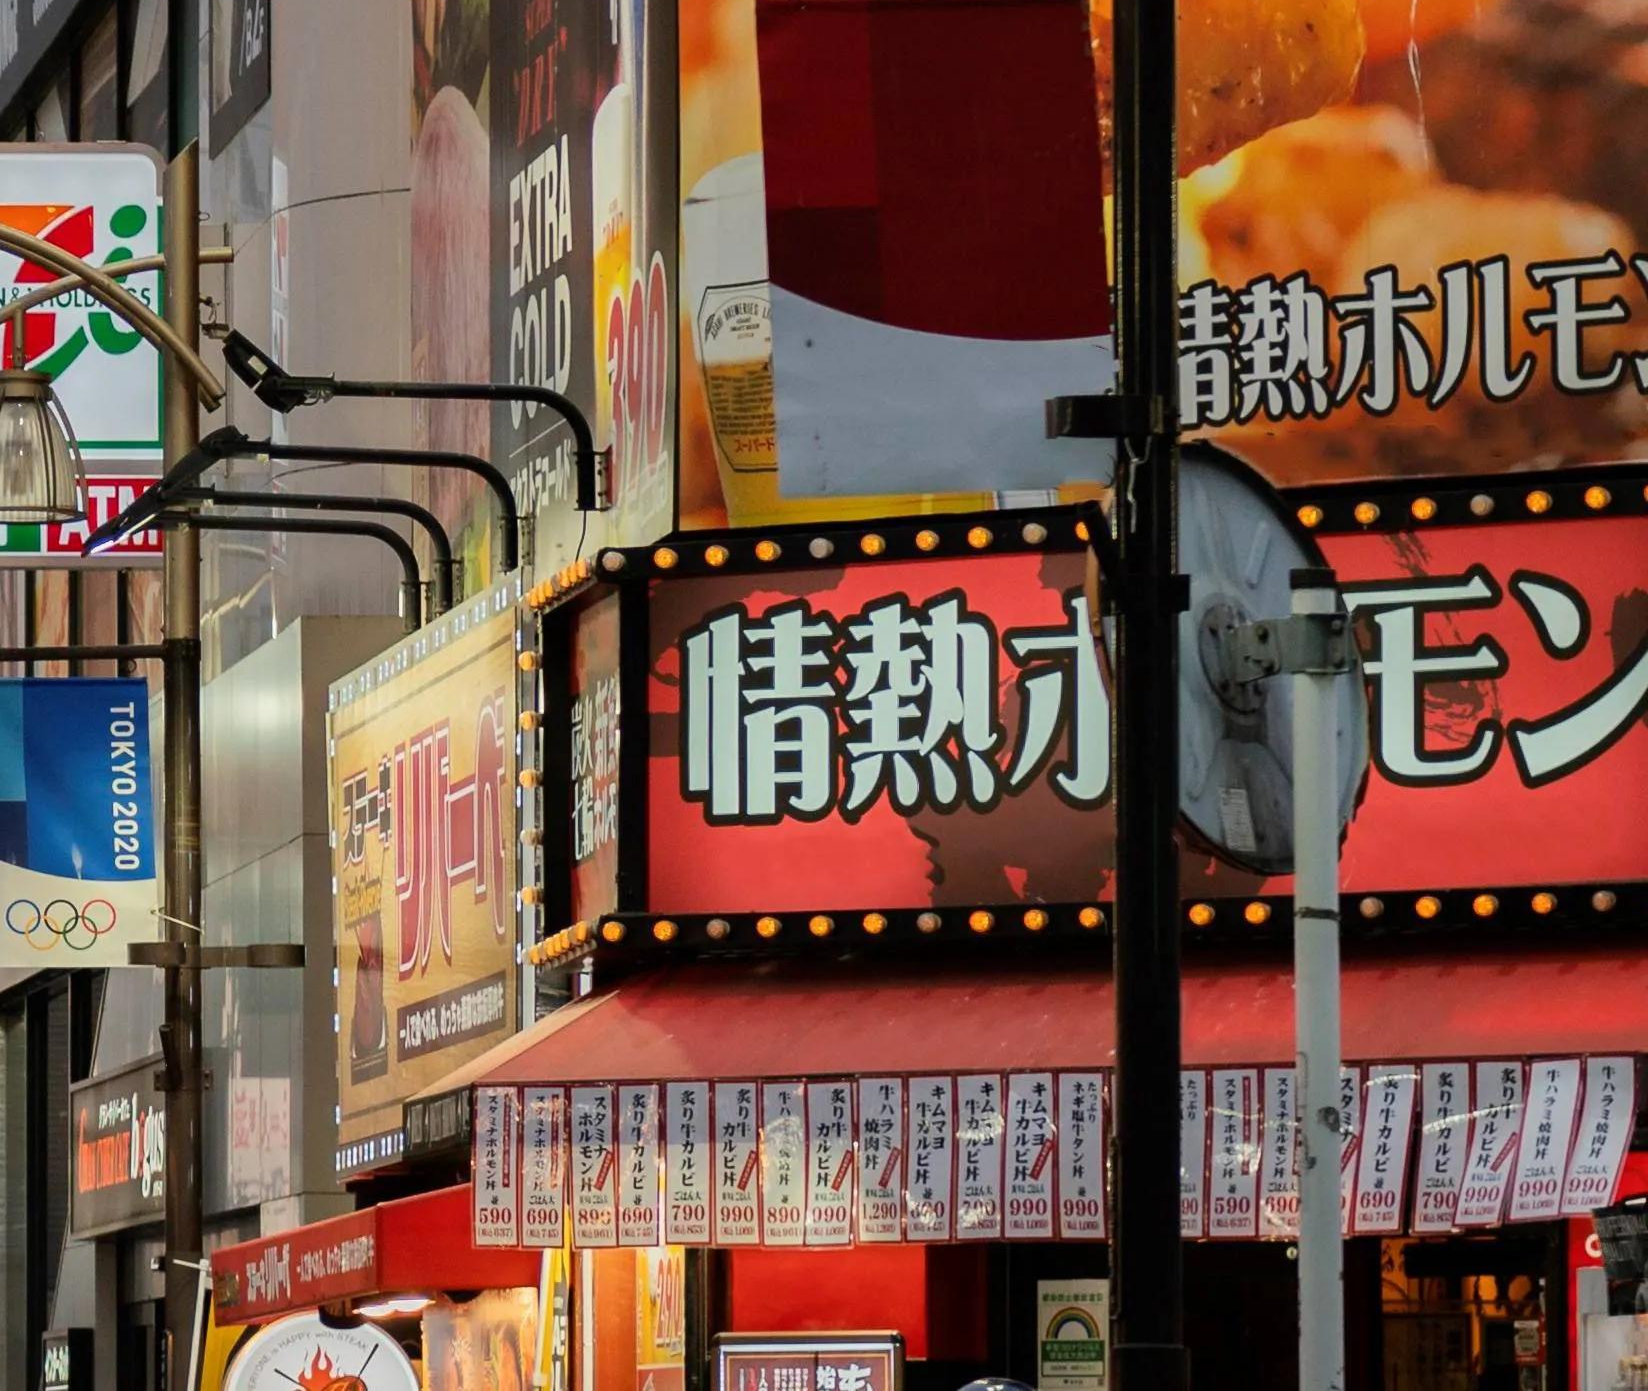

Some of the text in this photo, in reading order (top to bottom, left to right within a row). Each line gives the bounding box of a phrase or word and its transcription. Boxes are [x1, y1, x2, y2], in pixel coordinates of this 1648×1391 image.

[509, 133, 573, 297] EXTRA
[1177, 250, 1648, 426] 情熱ホルモ
[509, 273, 572, 430] COLD
[685, 570, 1648, 821] 情熱ホモン
[109, 701, 141, 871] TOKYO 2020
[1031, 1081, 1048, 1147] キムマヨ
[680, 1089, 696, 1187] 炙り牛カルビ
[1013, 1098, 1031, 1182] 牛カルビ丼
[1463, 1186, 1501, 1204] 990
[1519, 1178, 1557, 1197] 990
[1568, 1176, 1608, 1195] 990
[1009, 1198, 1048, 1216] 990
[1063, 1198, 1099, 1217] 990
[1214, 1196, 1251, 1215] 590
[1360, 1190, 1396, 1209] 690
[1422, 1190, 1456, 1210] 790
[479, 1207, 513, 1226] 590
[526, 1207, 559, 1226] 690
[621, 1207, 653, 1225] 690
[671, 1204, 705, 1222] 790
[720, 1205, 754, 1223] 990
[766, 1206, 801, 1223] 890
[278, 1331, 312, 1349] HAPPY
[336, 1331, 370, 1352] STEAK
